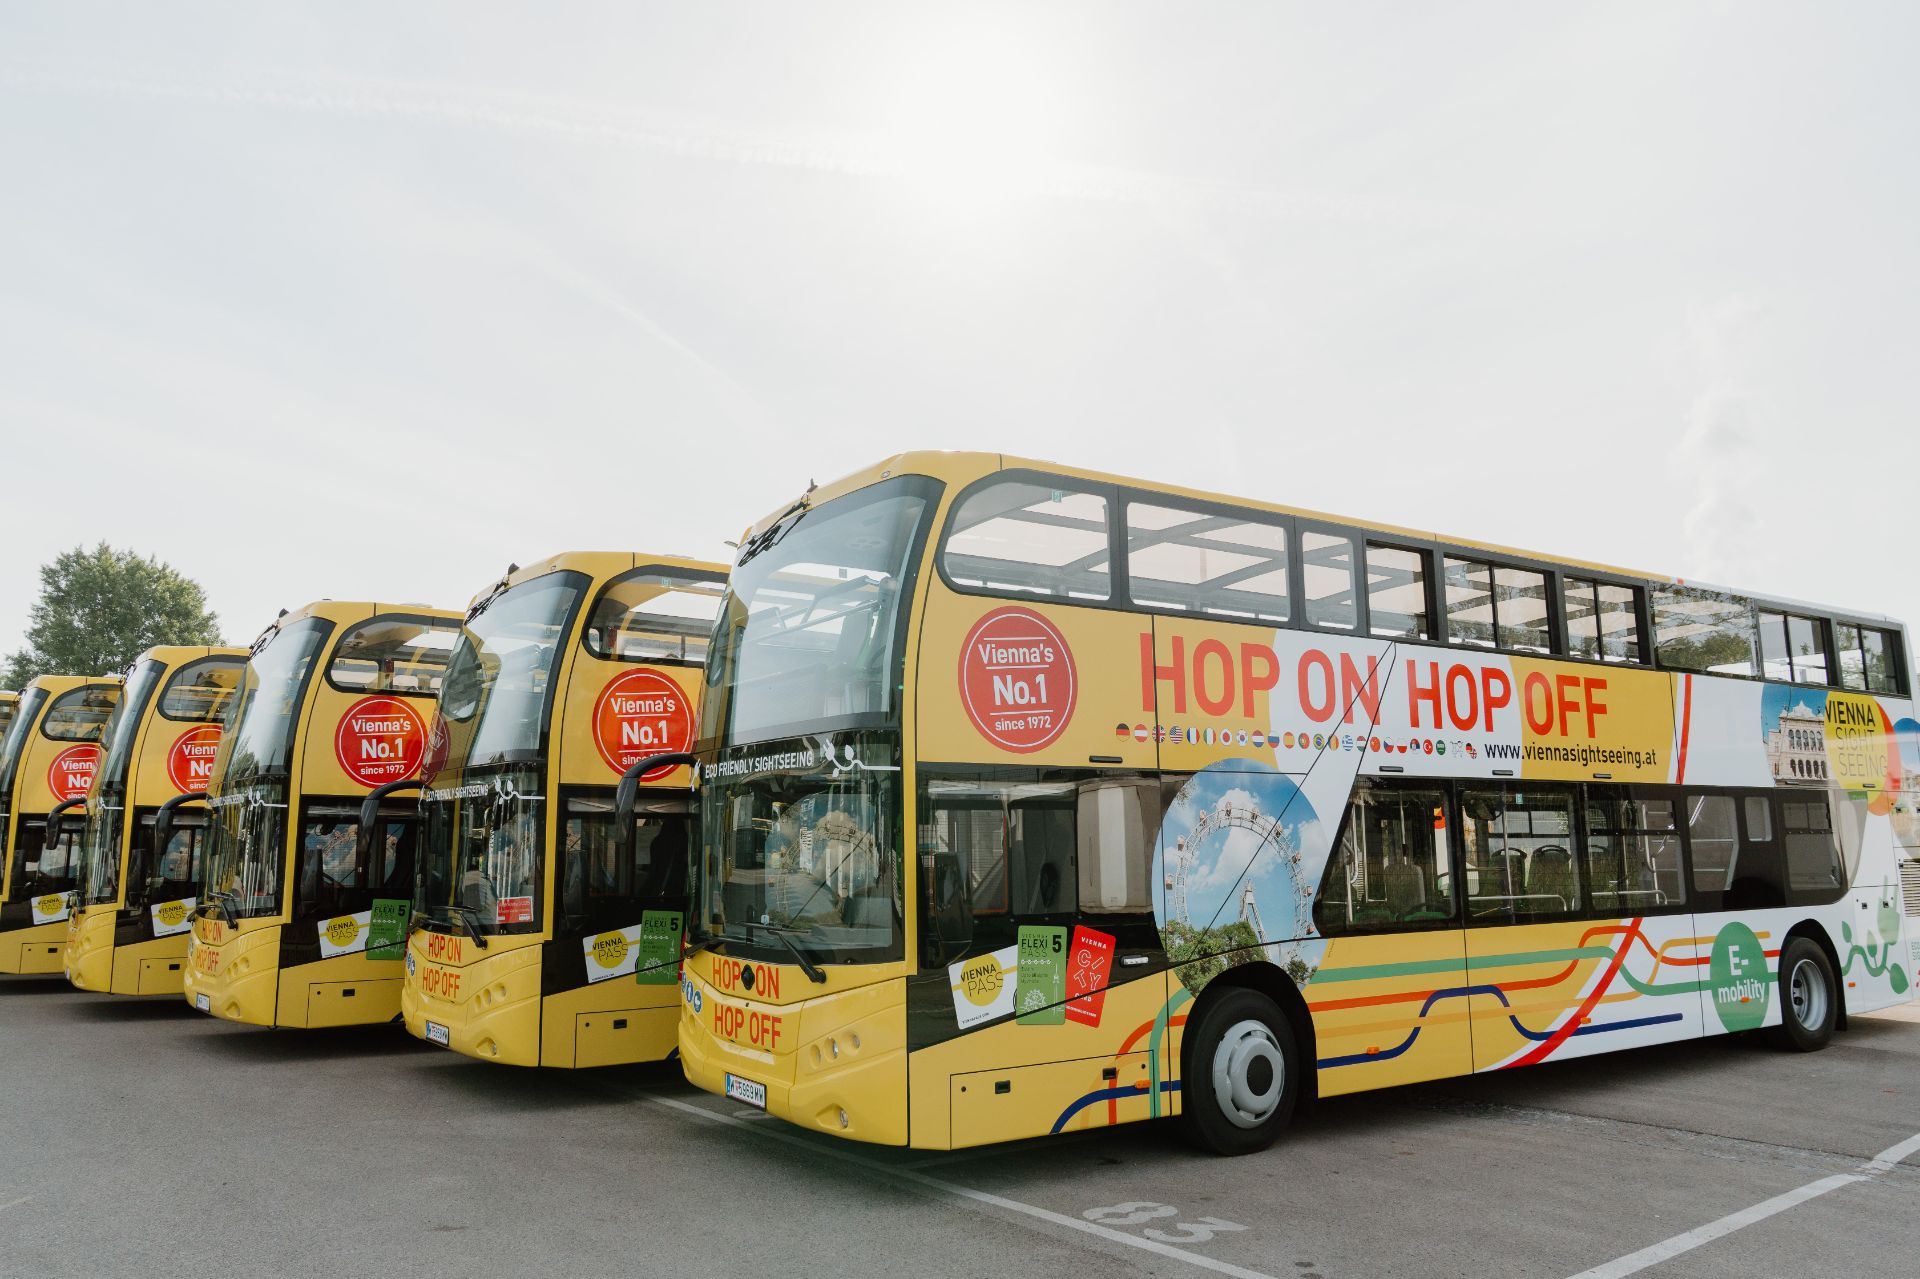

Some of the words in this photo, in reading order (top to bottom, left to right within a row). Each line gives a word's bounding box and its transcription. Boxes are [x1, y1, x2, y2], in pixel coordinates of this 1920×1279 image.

[978, 643, 1054, 664] Vienna's
[993, 674, 1047, 706] No.1
[1140, 633, 1280, 718] HOP
[1298, 649, 1380, 725] ON
[1406, 659, 1511, 732] HOP
[1524, 671, 1607, 738] OFF
[611, 697, 675, 714] Vienna's
[1825, 700, 1876, 727] VIENNA
[352, 718, 411, 732] Vienna's
[622, 720, 668, 745] No.1
[995, 718, 1024, 731] since
[1027, 716, 1051, 729] 1972
[361, 738, 403, 759] No.1
[1835, 727, 1875, 751] SIGHT
[705, 764, 718, 779] ECO
[718, 759, 754, 776] FRIENDLY
[754, 751, 813, 772] SIGHTSEEING
[1484, 741, 1657, 769] www.viennasightseeing.at
[1838, 753, 1888, 777] SEEING
[360, 766, 384, 775] since
[386, 765, 405, 774] 1972
[158, 905, 183, 915] VIENNA
[398, 904, 407, 917] 5
[326, 921, 354, 933] VIENNA
[331, 926, 359, 941] PASS
[670, 917, 680, 931] 5
[428, 934, 446, 960] HOP
[447, 937, 462, 963] ON
[592, 937, 623, 950] VIENNA
[598, 943, 628, 961] PASS
[1052, 934, 1063, 953] 5
[1081, 936, 1107, 950] VIENNA
[1728, 945, 1749, 976] E-
[422, 966, 440, 993] HOP
[441, 972, 461, 998] OFF
[712, 957, 741, 991] HOP
[755, 965, 780, 999] ON
[960, 963, 997, 982] VIENNA
[967, 971, 1004, 997] PASS
[1718, 978, 1766, 1004] mobility
[714, 1003, 745, 1039] HOP
[749, 1012, 782, 1049] OFF
